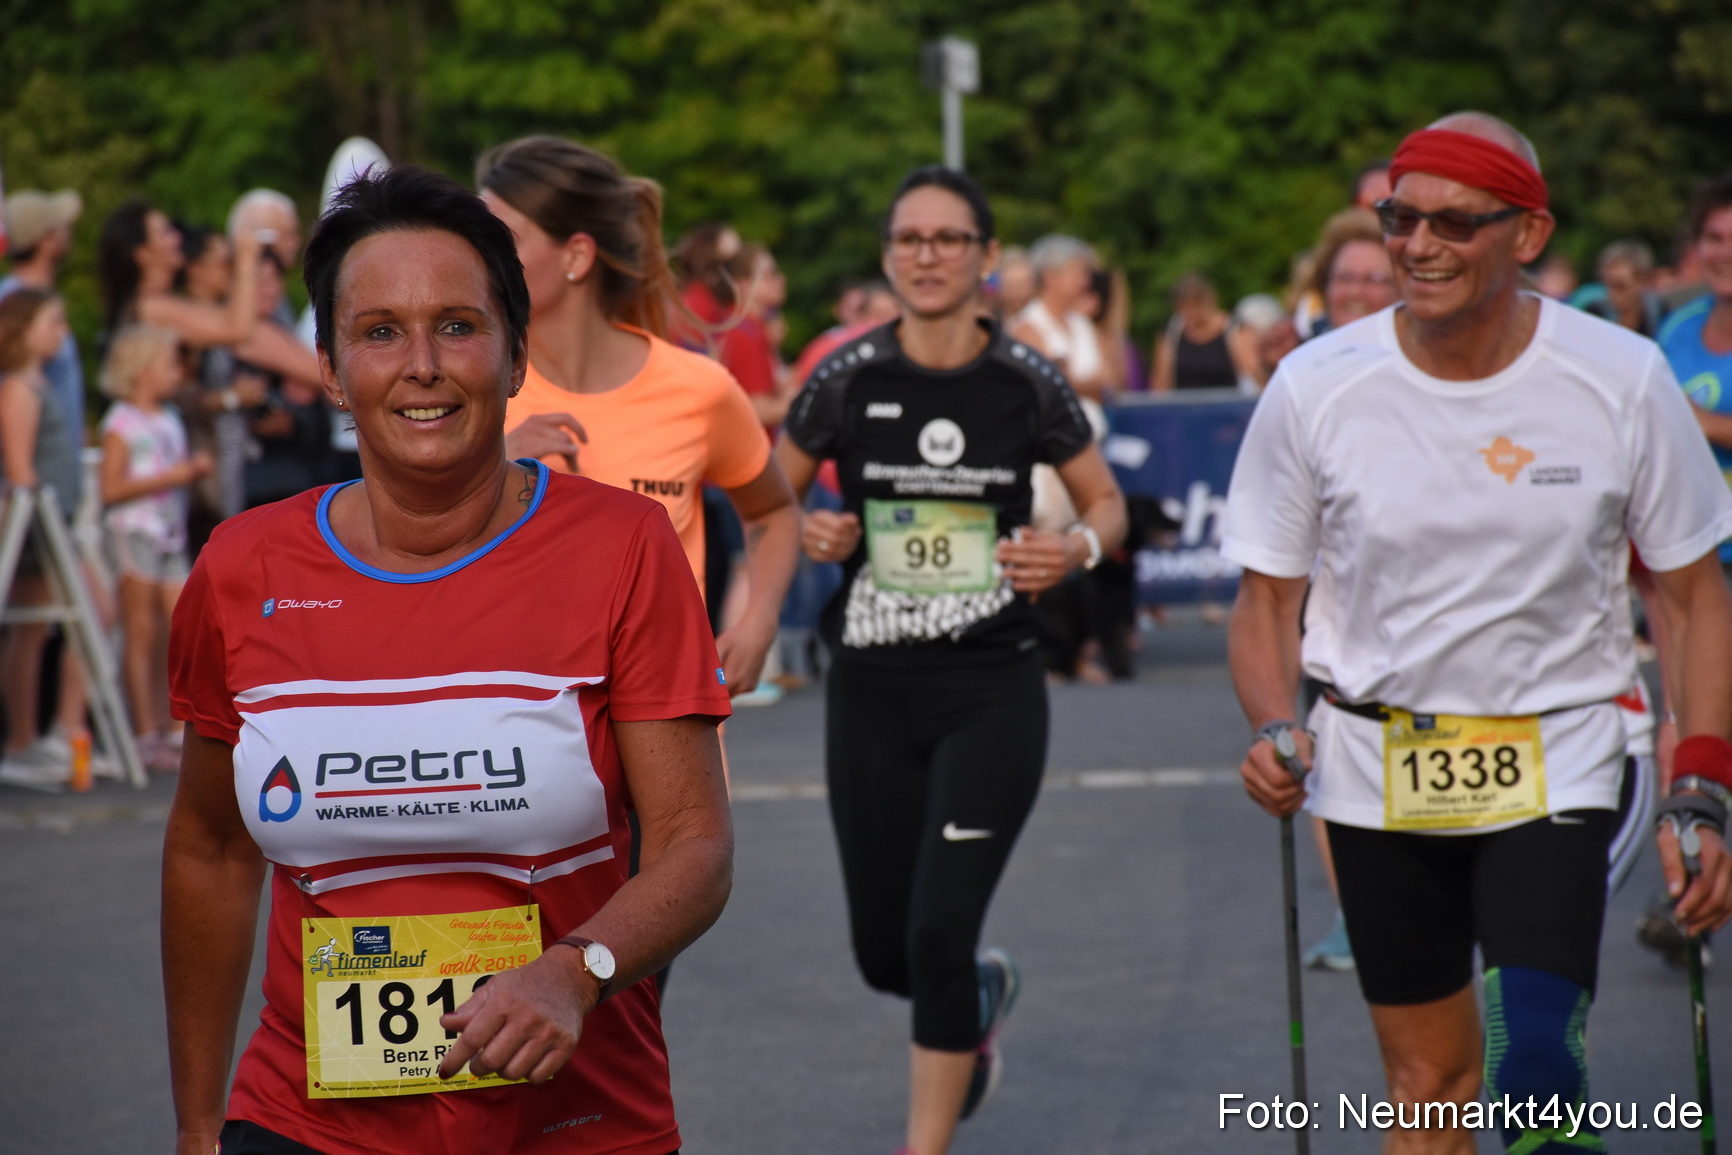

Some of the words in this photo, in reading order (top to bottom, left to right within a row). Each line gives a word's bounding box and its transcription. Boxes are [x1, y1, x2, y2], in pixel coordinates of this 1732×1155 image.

[905, 536, 952, 569] 98
[315, 746, 526, 790] Petry
[1402, 744, 1521, 792] 1338
[315, 805, 389, 821] WÄRME
[398, 801, 461, 818] KÄLTE
[470, 797, 530, 813] KLIMA
[449, 918, 492, 930] Gesunde
[468, 930, 498, 943] laufen
[337, 949, 428, 969] firmenlauf
[439, 953, 482, 975] walk
[484, 954, 527, 972] 2019
[338, 969, 377, 977] neumarkt
[335, 974, 495, 1046] 181
[383, 1048, 429, 1064] Benz
[400, 1066, 431, 1078] Petry
